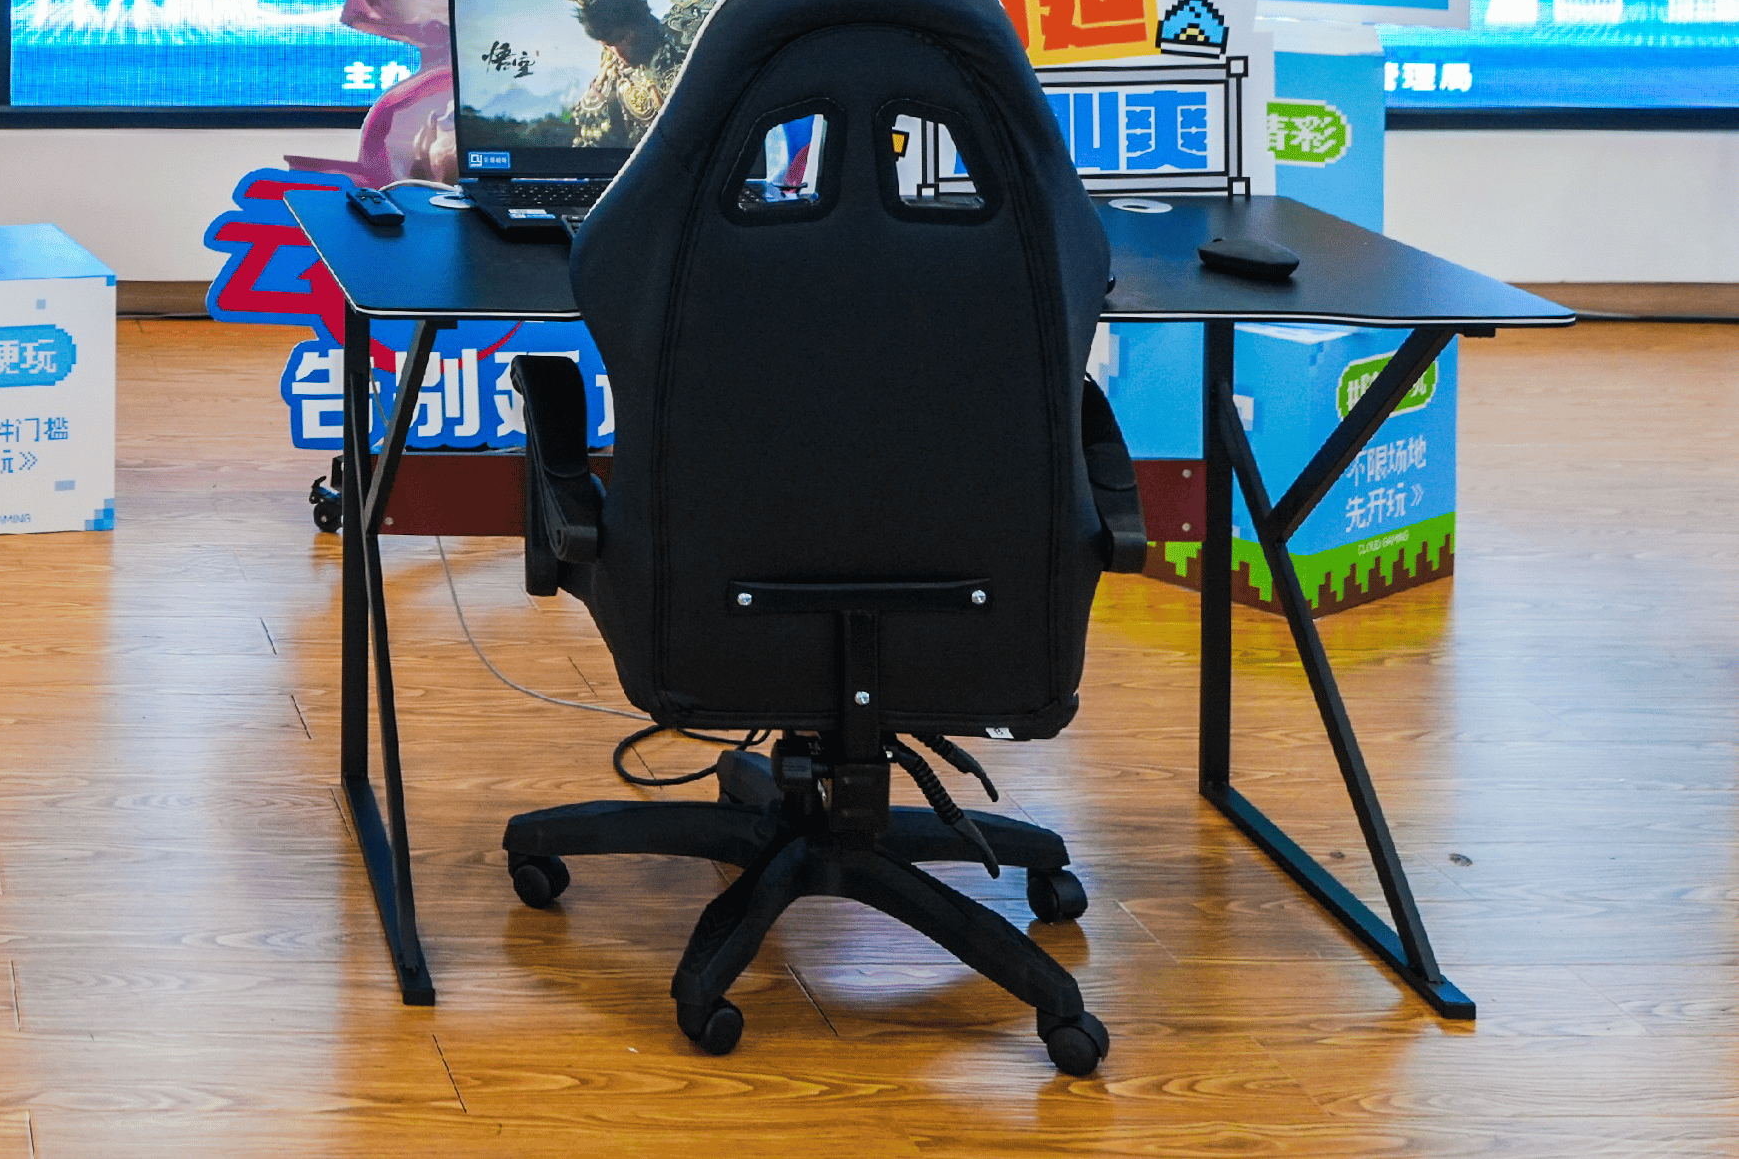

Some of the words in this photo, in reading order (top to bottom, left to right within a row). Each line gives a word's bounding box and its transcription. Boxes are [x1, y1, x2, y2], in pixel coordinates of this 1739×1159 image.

[1346, 434, 1427, 487] 不限场地
[1345, 482, 1407, 533] 先开玩
